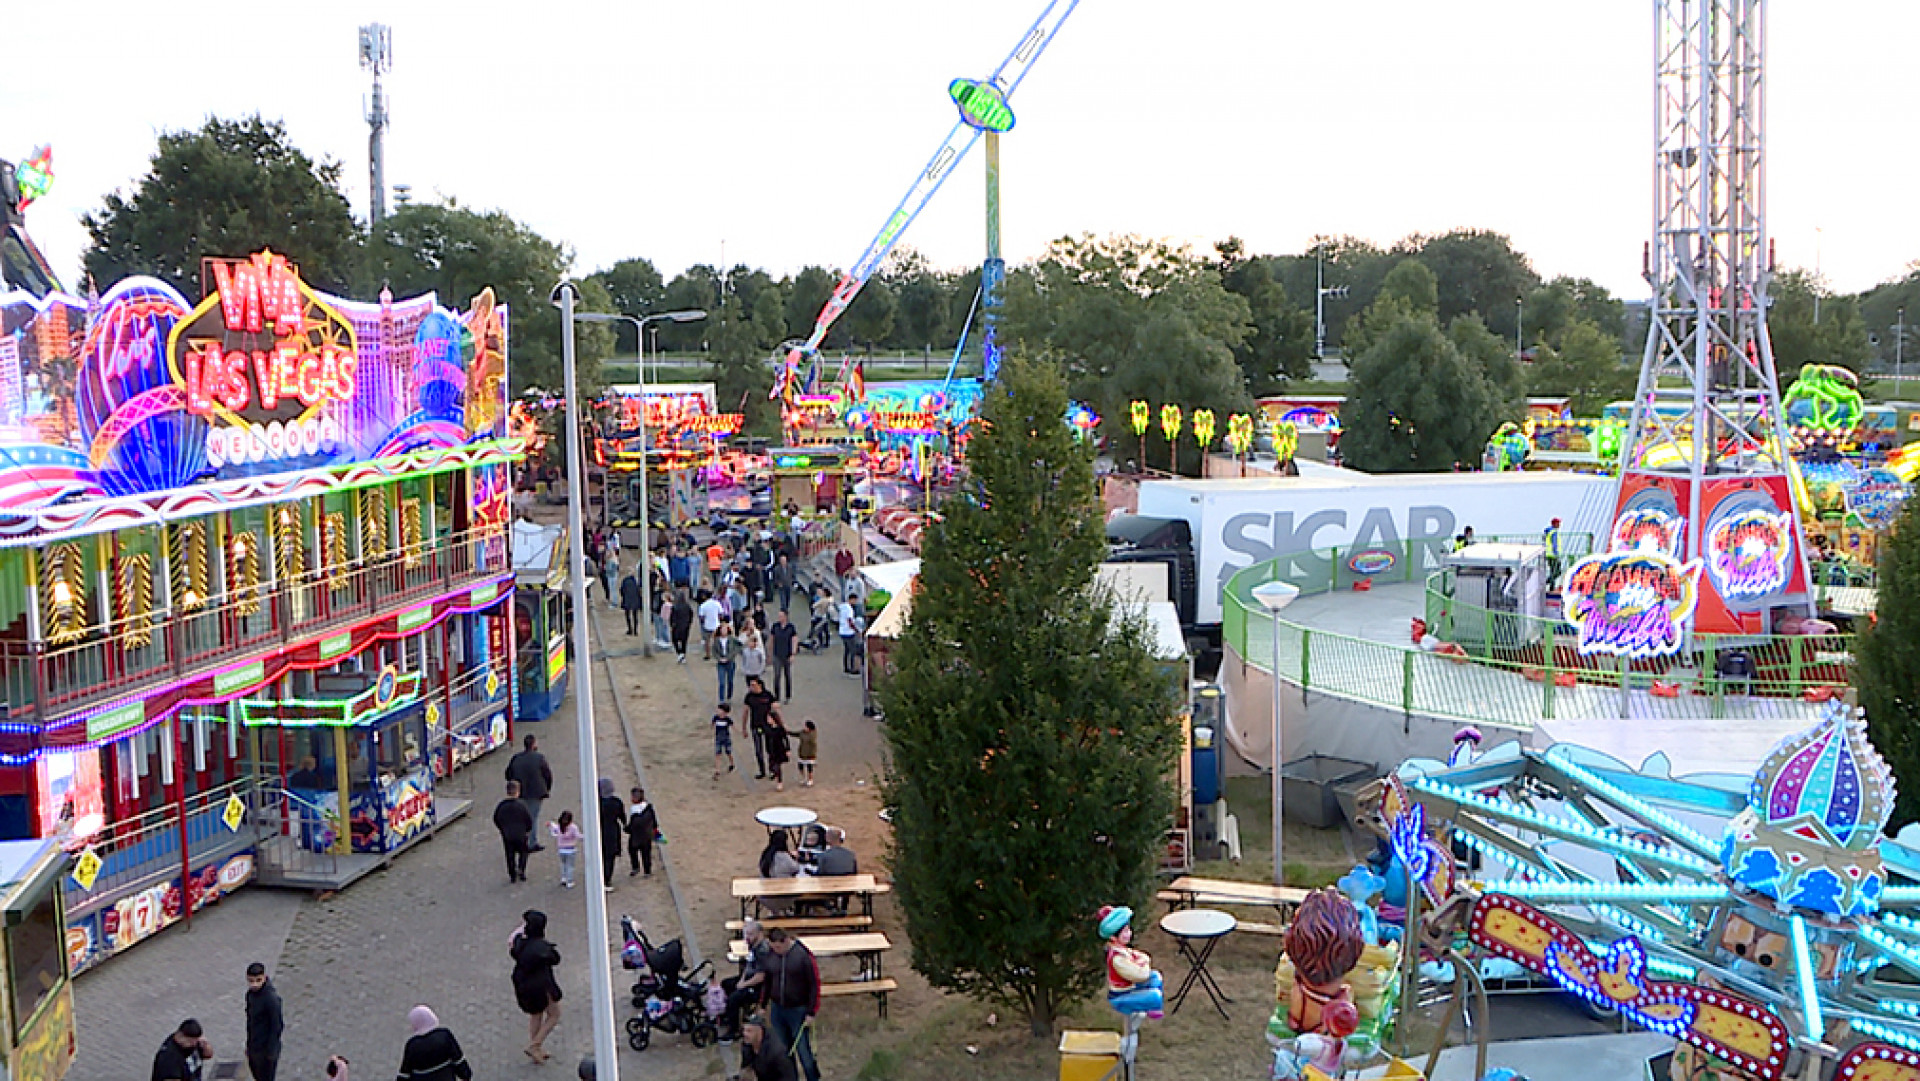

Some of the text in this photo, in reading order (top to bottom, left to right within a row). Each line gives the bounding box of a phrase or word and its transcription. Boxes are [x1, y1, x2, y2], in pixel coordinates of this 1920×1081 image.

[212, 252, 306, 335] VIVA
[185, 340, 249, 415] LAS
[251, 338, 355, 410] VEGAS
[211, 428, 335, 453] WELCOME
[1217, 505, 1456, 580] SICAR
